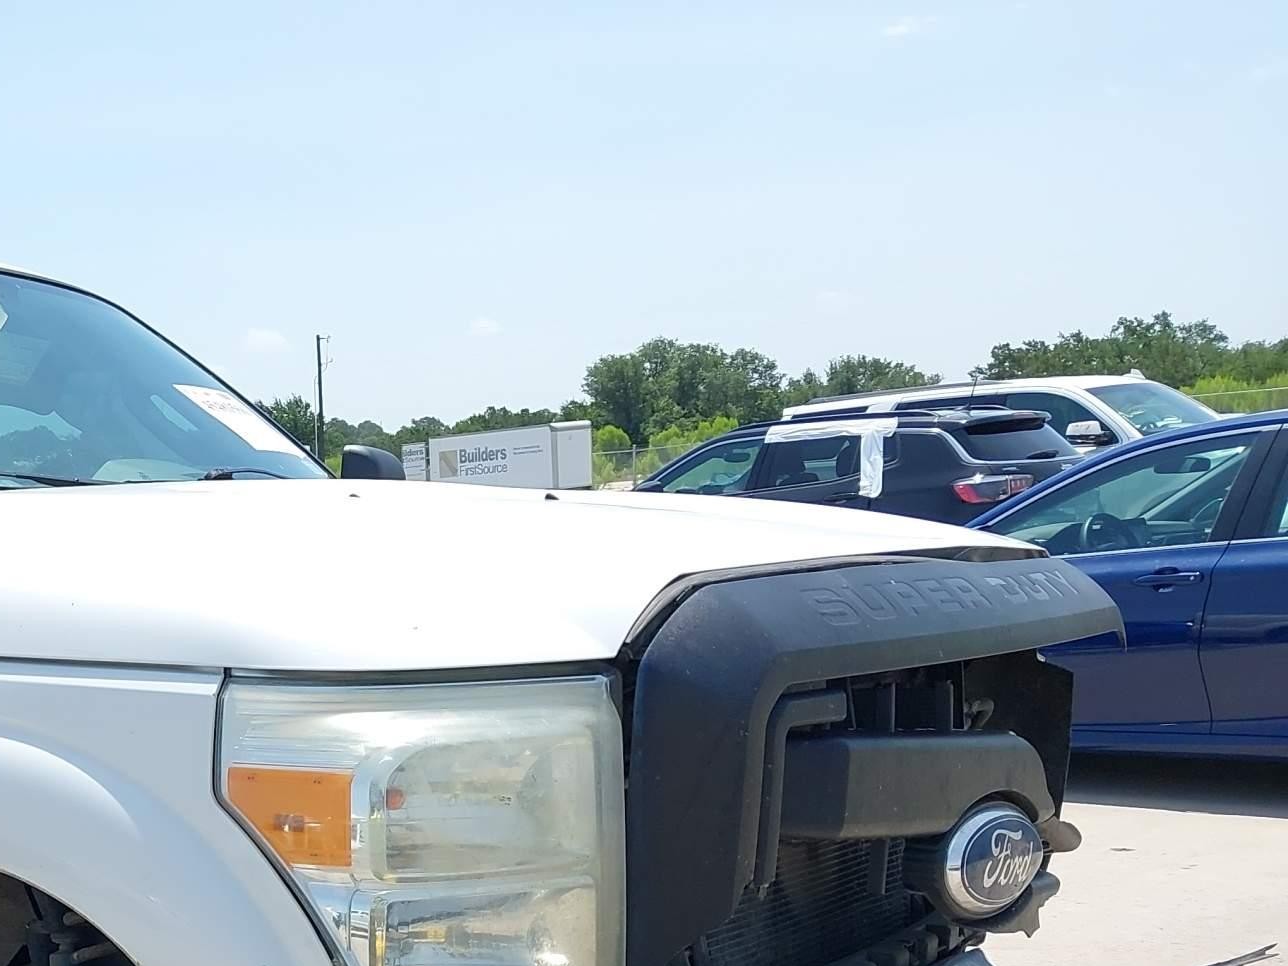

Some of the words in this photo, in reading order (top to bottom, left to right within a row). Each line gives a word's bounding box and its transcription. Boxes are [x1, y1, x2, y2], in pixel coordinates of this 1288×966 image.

[459, 446, 508, 464] Builders
[459, 463, 508, 477] FirstSource
[801, 577, 992, 626] SUPER
[984, 571, 1080, 604] DUTY
[983, 828, 1034, 888] Ford
